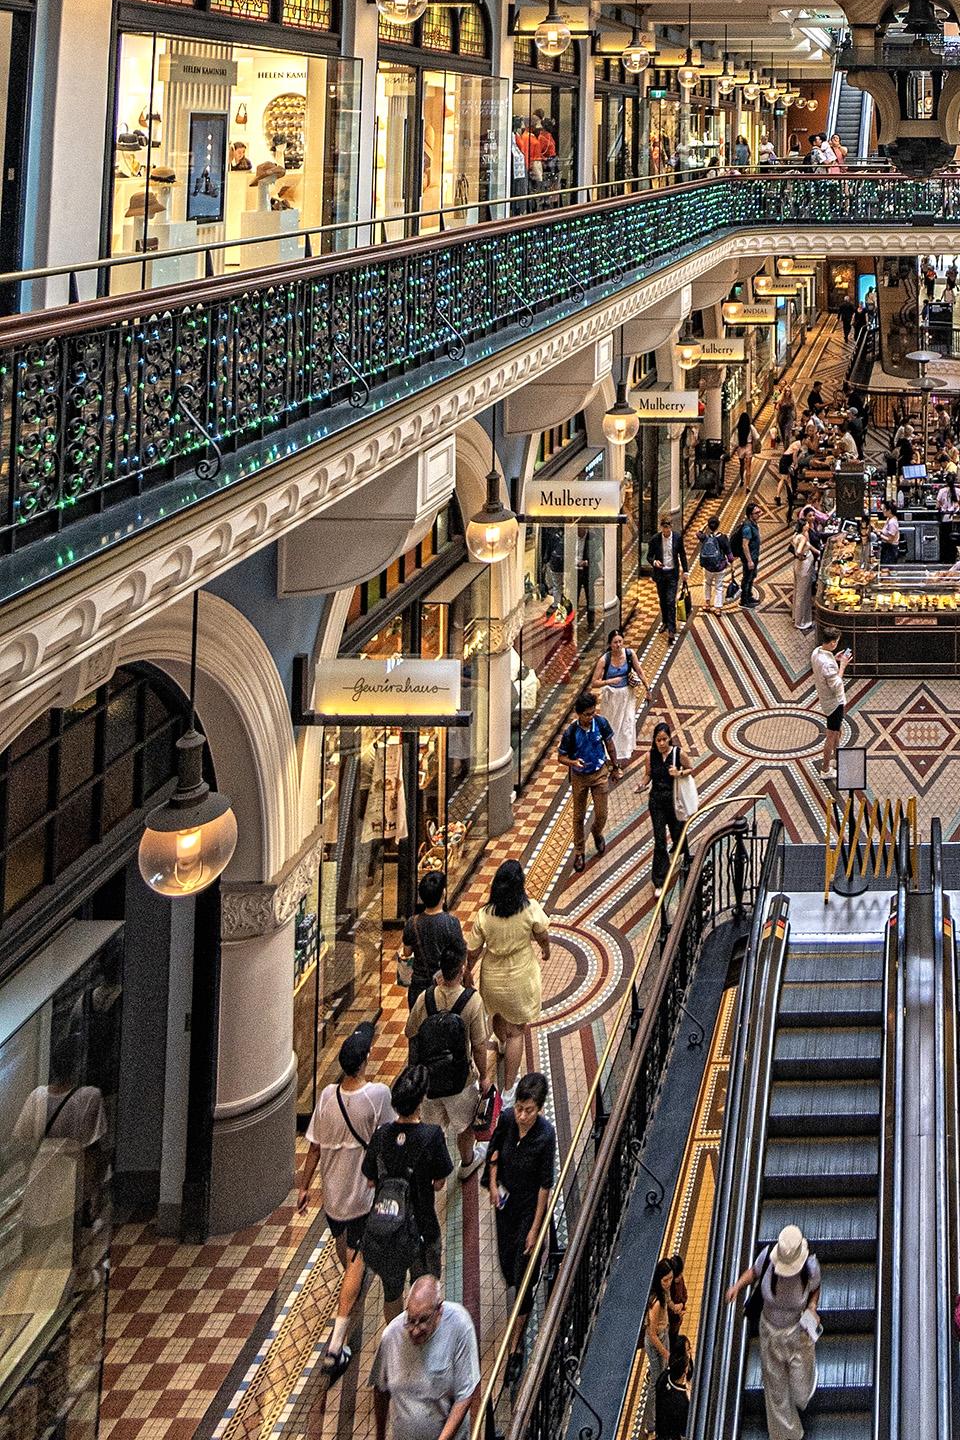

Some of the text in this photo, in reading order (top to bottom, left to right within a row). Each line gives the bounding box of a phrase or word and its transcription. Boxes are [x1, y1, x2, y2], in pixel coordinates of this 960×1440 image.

[183, 64, 227, 77] HELEN KAMINSKI
[258, 71, 283, 79] HELEN
[639, 397, 686, 413] Mulberry
[540, 489, 602, 510] Mulberry
